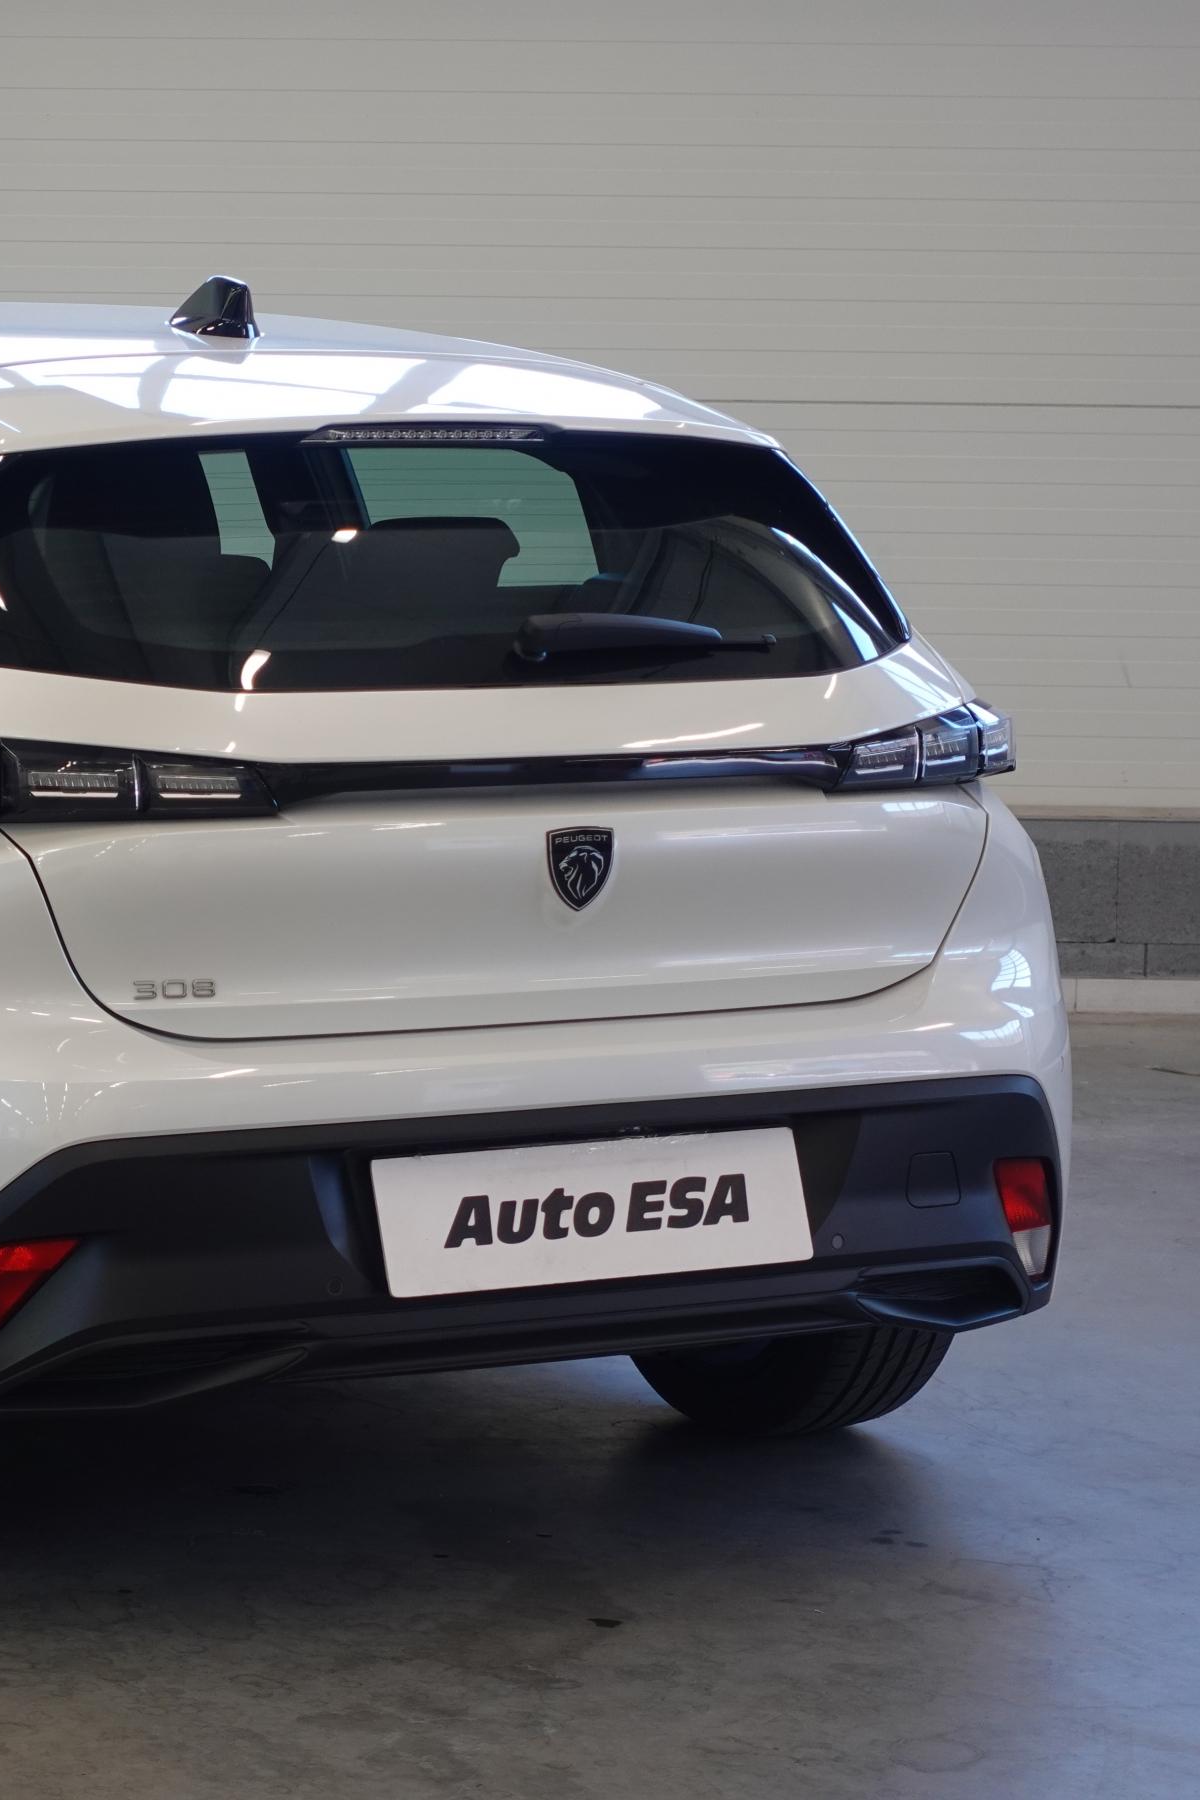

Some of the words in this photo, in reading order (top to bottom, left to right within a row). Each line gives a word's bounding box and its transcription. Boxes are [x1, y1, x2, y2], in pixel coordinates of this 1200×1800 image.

[555, 834, 608, 844] PEUGEOT
[133, 978, 216, 1000] 308
[444, 1188, 615, 1248] Auto
[626, 1173, 749, 1232] ESA
